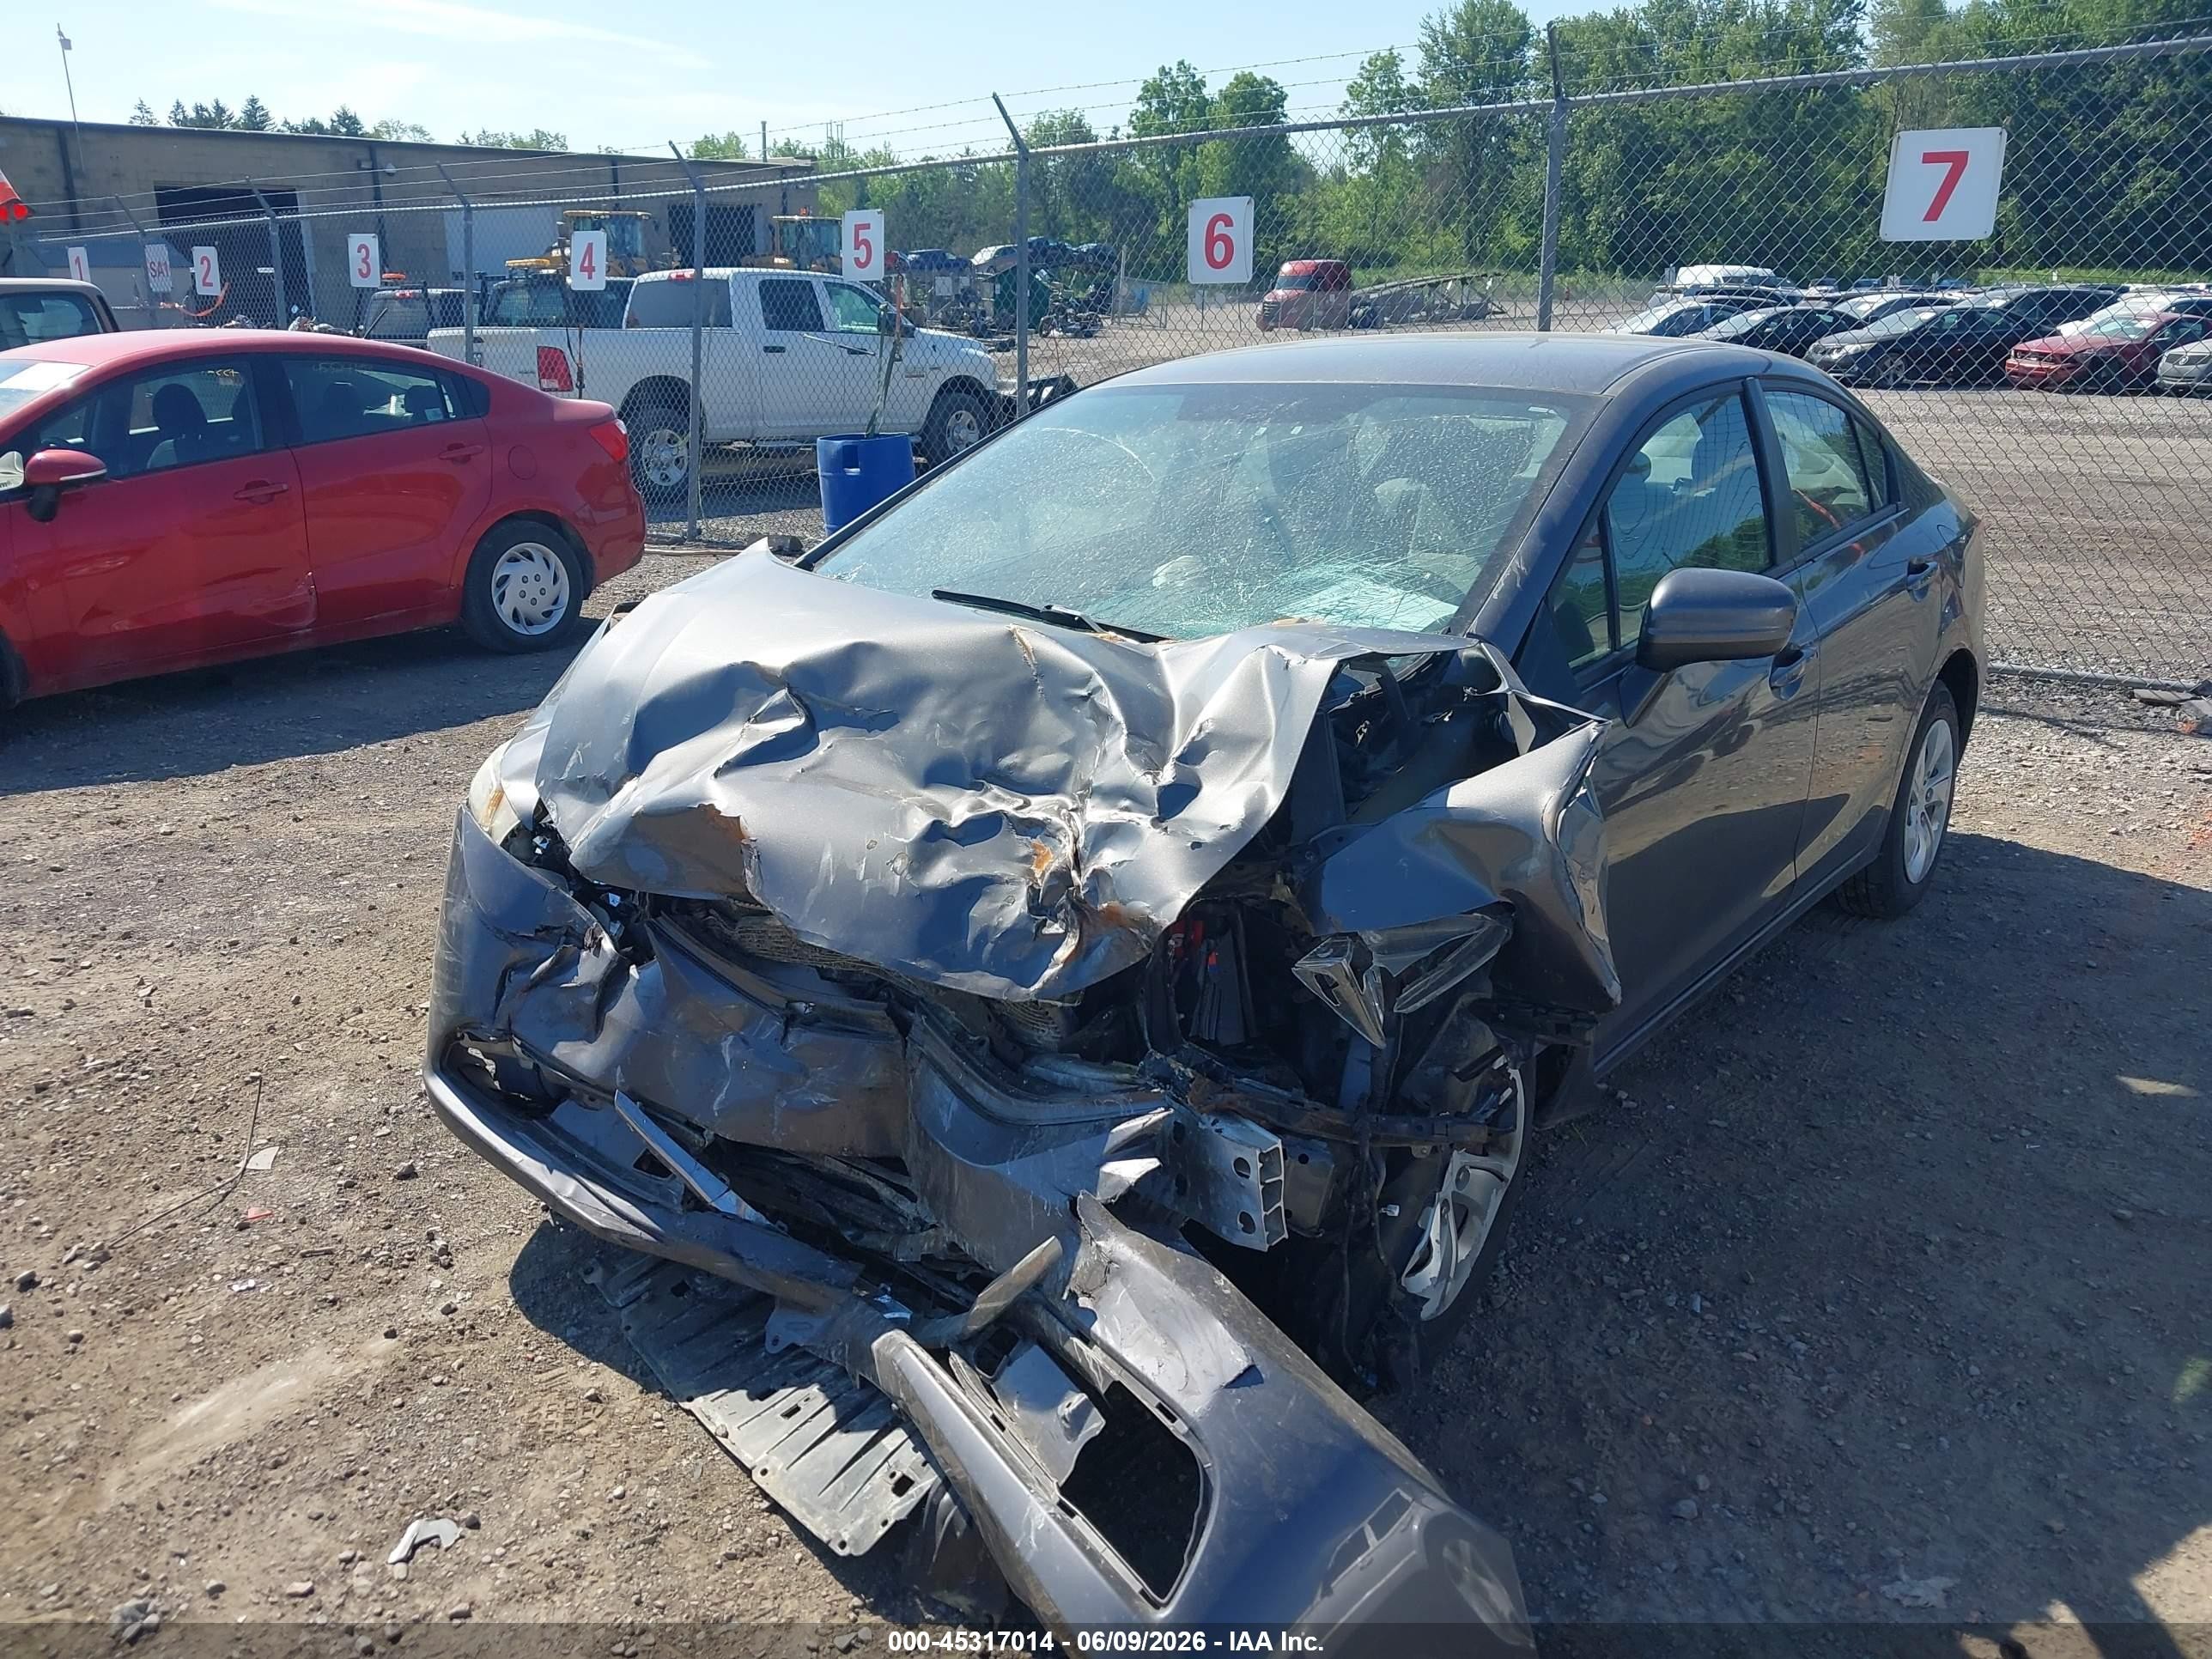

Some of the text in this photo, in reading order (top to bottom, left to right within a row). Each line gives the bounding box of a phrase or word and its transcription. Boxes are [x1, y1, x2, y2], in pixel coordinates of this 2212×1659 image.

[1921, 150, 1970, 222] 7
[854, 222, 872, 270] 5
[1205, 213, 1234, 270] 6
[75, 256, 83, 281] 1
[149, 261, 171, 278] SA1
[200, 255, 214, 288] 2
[356, 243, 372, 279] 3
[579, 241, 596, 280] 4
